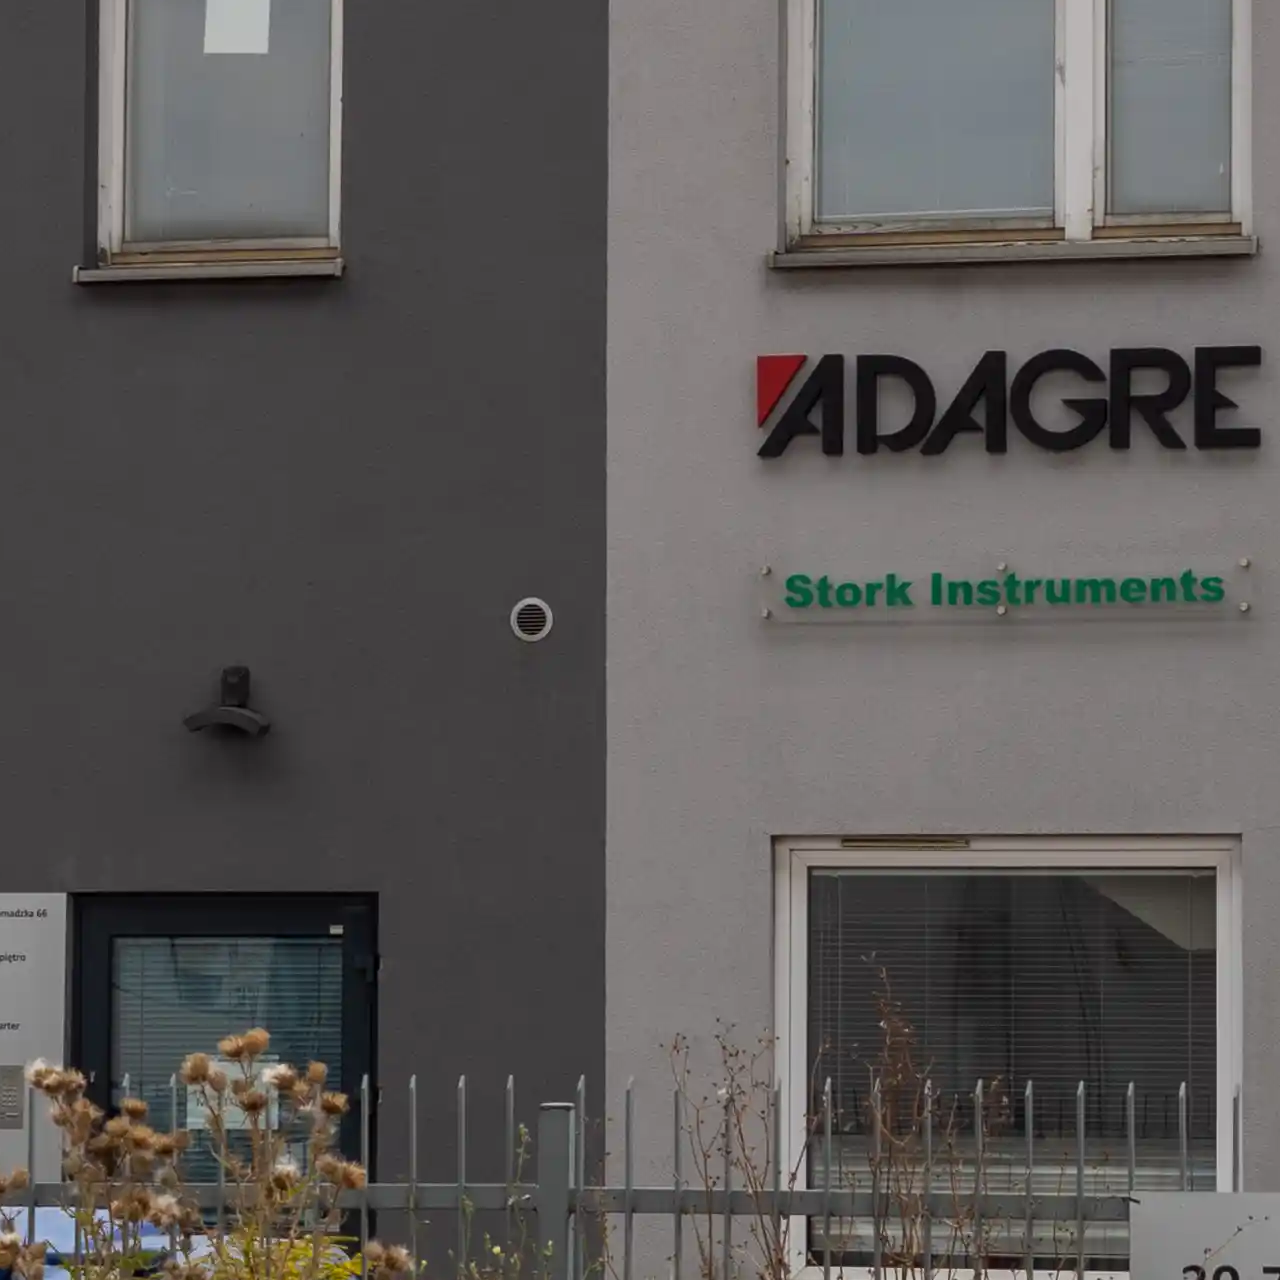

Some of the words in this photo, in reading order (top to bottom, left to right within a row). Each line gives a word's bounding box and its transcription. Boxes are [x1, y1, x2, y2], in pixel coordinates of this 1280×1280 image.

[757, 346, 1262, 457] ADAGRE
[784, 573, 913, 609] Stork
[930, 567, 1226, 607] Instruments
[36, 908, 48, 918] 66
